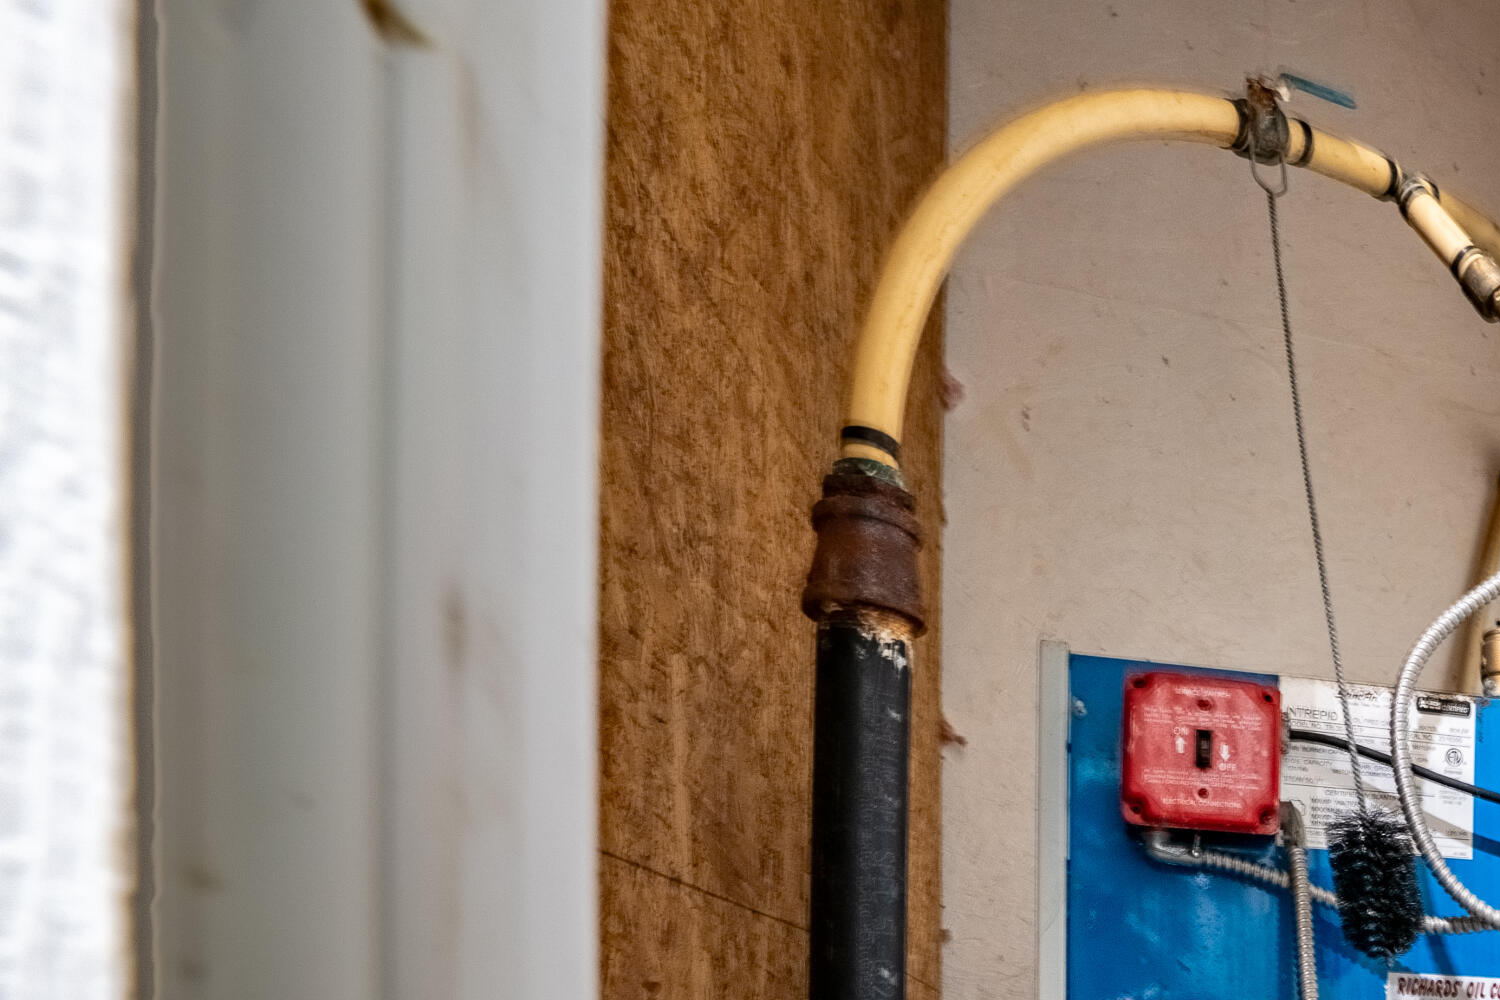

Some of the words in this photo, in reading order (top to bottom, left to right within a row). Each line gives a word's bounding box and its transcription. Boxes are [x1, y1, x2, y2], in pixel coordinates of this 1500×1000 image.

[1173, 726, 1189, 736] ON
[1218, 762, 1237, 771] OFF
[1466, 982, 1485, 999] OIL
